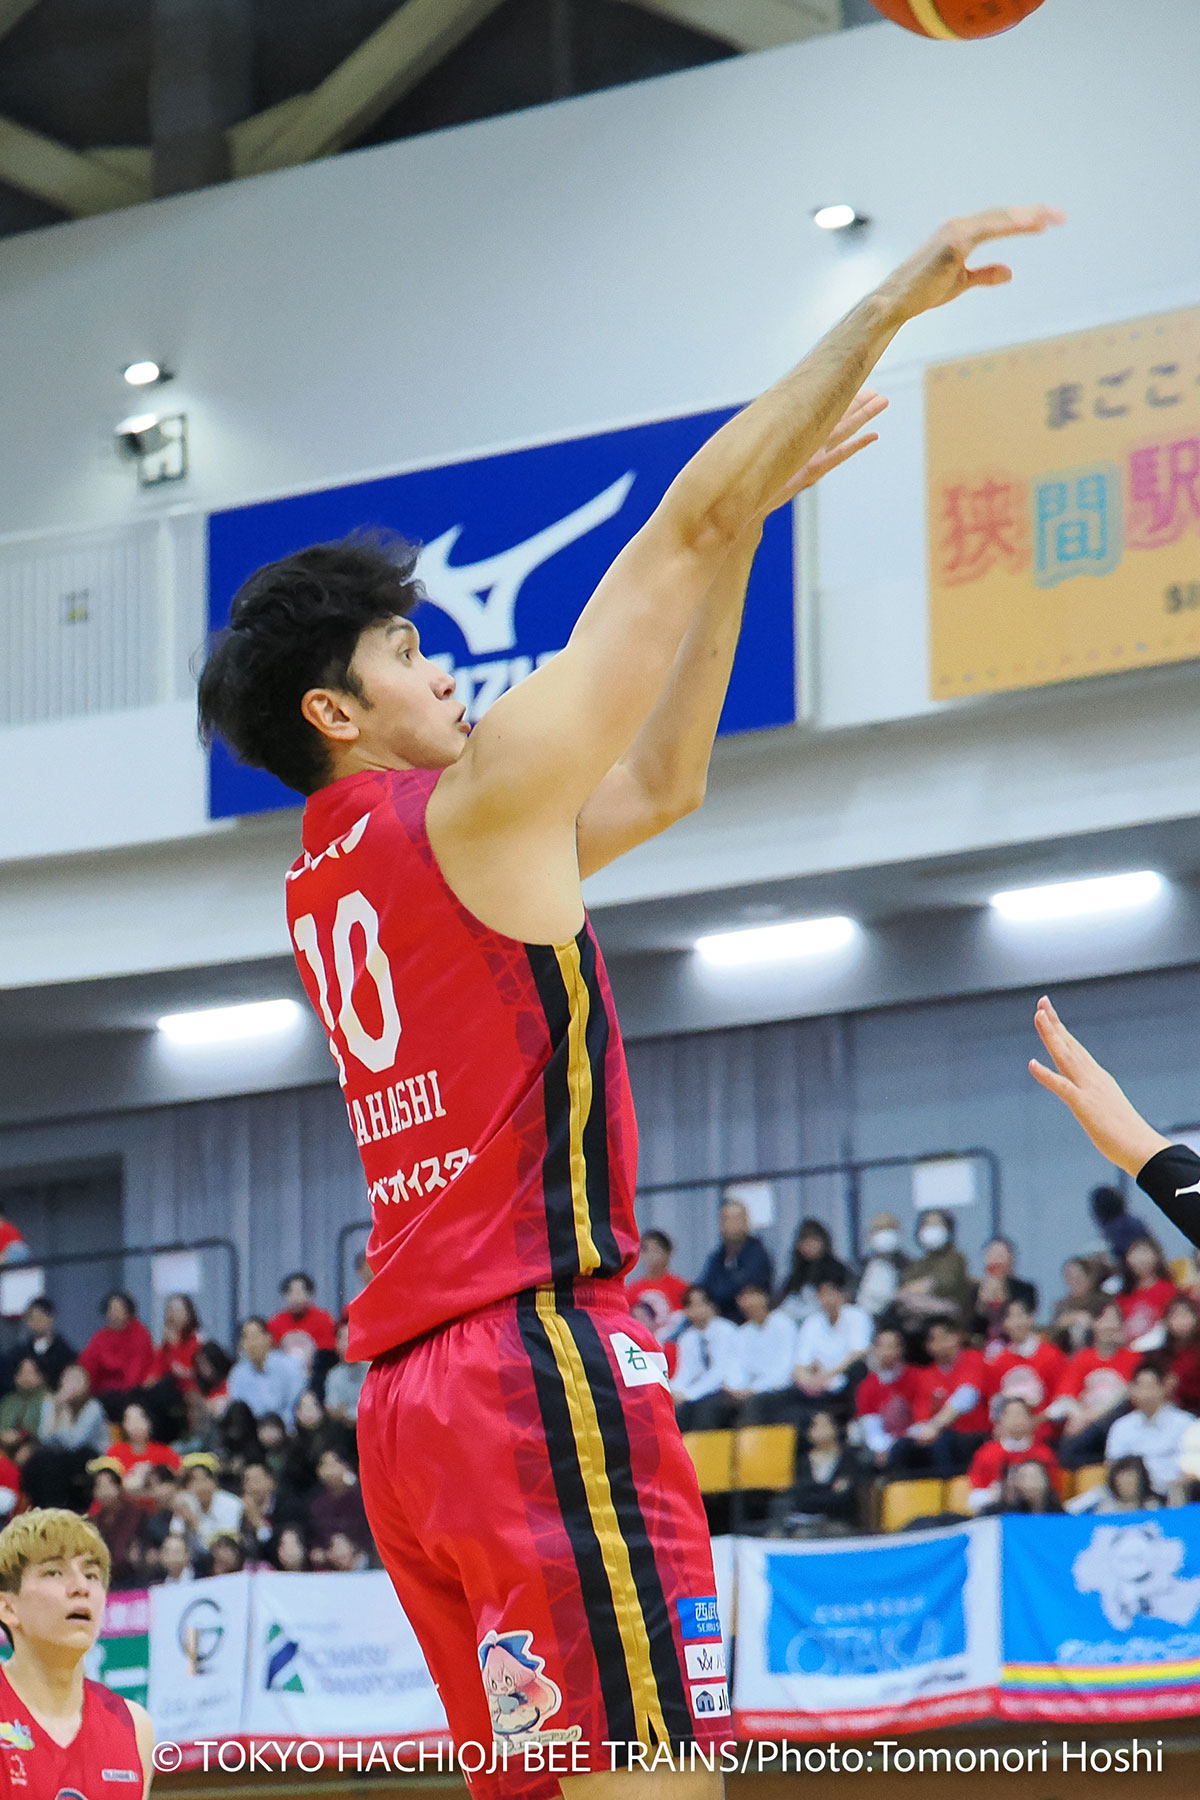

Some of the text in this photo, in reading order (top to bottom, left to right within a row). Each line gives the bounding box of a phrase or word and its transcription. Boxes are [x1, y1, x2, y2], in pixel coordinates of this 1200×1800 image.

[294, 890, 402, 1088] 10
[346, 1069, 447, 1147] AHASHI
[367, 1147, 477, 1205] ベオイスタ
